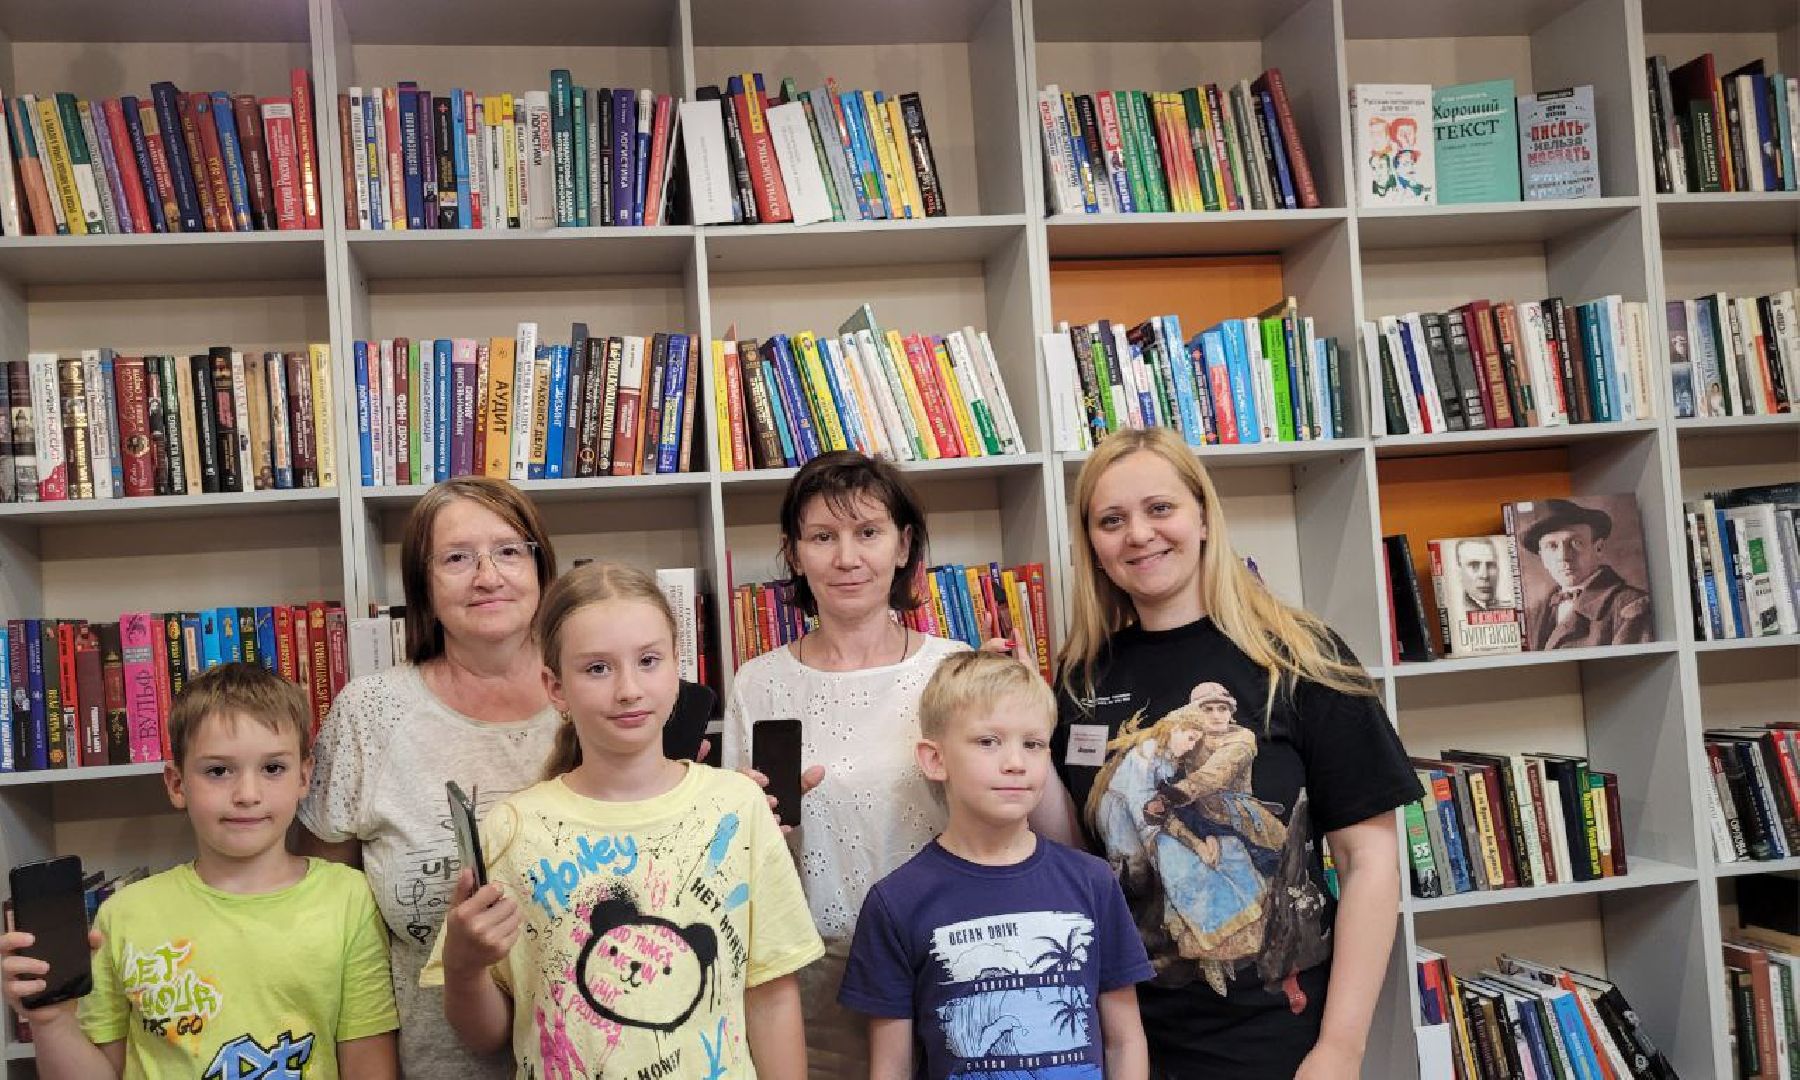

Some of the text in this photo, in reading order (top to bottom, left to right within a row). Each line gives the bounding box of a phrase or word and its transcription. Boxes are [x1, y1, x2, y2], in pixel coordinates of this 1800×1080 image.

[1433, 99, 1500, 121] Хороший
[531, 113, 542, 166] ЛОГИСТИКИ
[1434, 120, 1500, 140] ТЕКСТ
[1531, 119, 1584, 142] ПИСАТЬ
[620, 131, 629, 189] ЛОГИСТИКА
[758, 138, 781, 217] ЖУРНАЛИСТИКА
[454, 366, 465, 436] ЭКОНОМИЧЕСКИЙ
[465, 384, 474, 419] АНАЛИЗ
[492, 380, 509, 436] АУДИТ
[533, 429, 544, 459] ДЕЛО
[1458, 620, 1518, 651] Булгаков
[135, 669, 157, 740] ВУЛЬФ
[690, 876, 721, 914] HEY
[949, 922, 1019, 946] OCEAN DRIVE
[176, 1014, 204, 1035] GO
